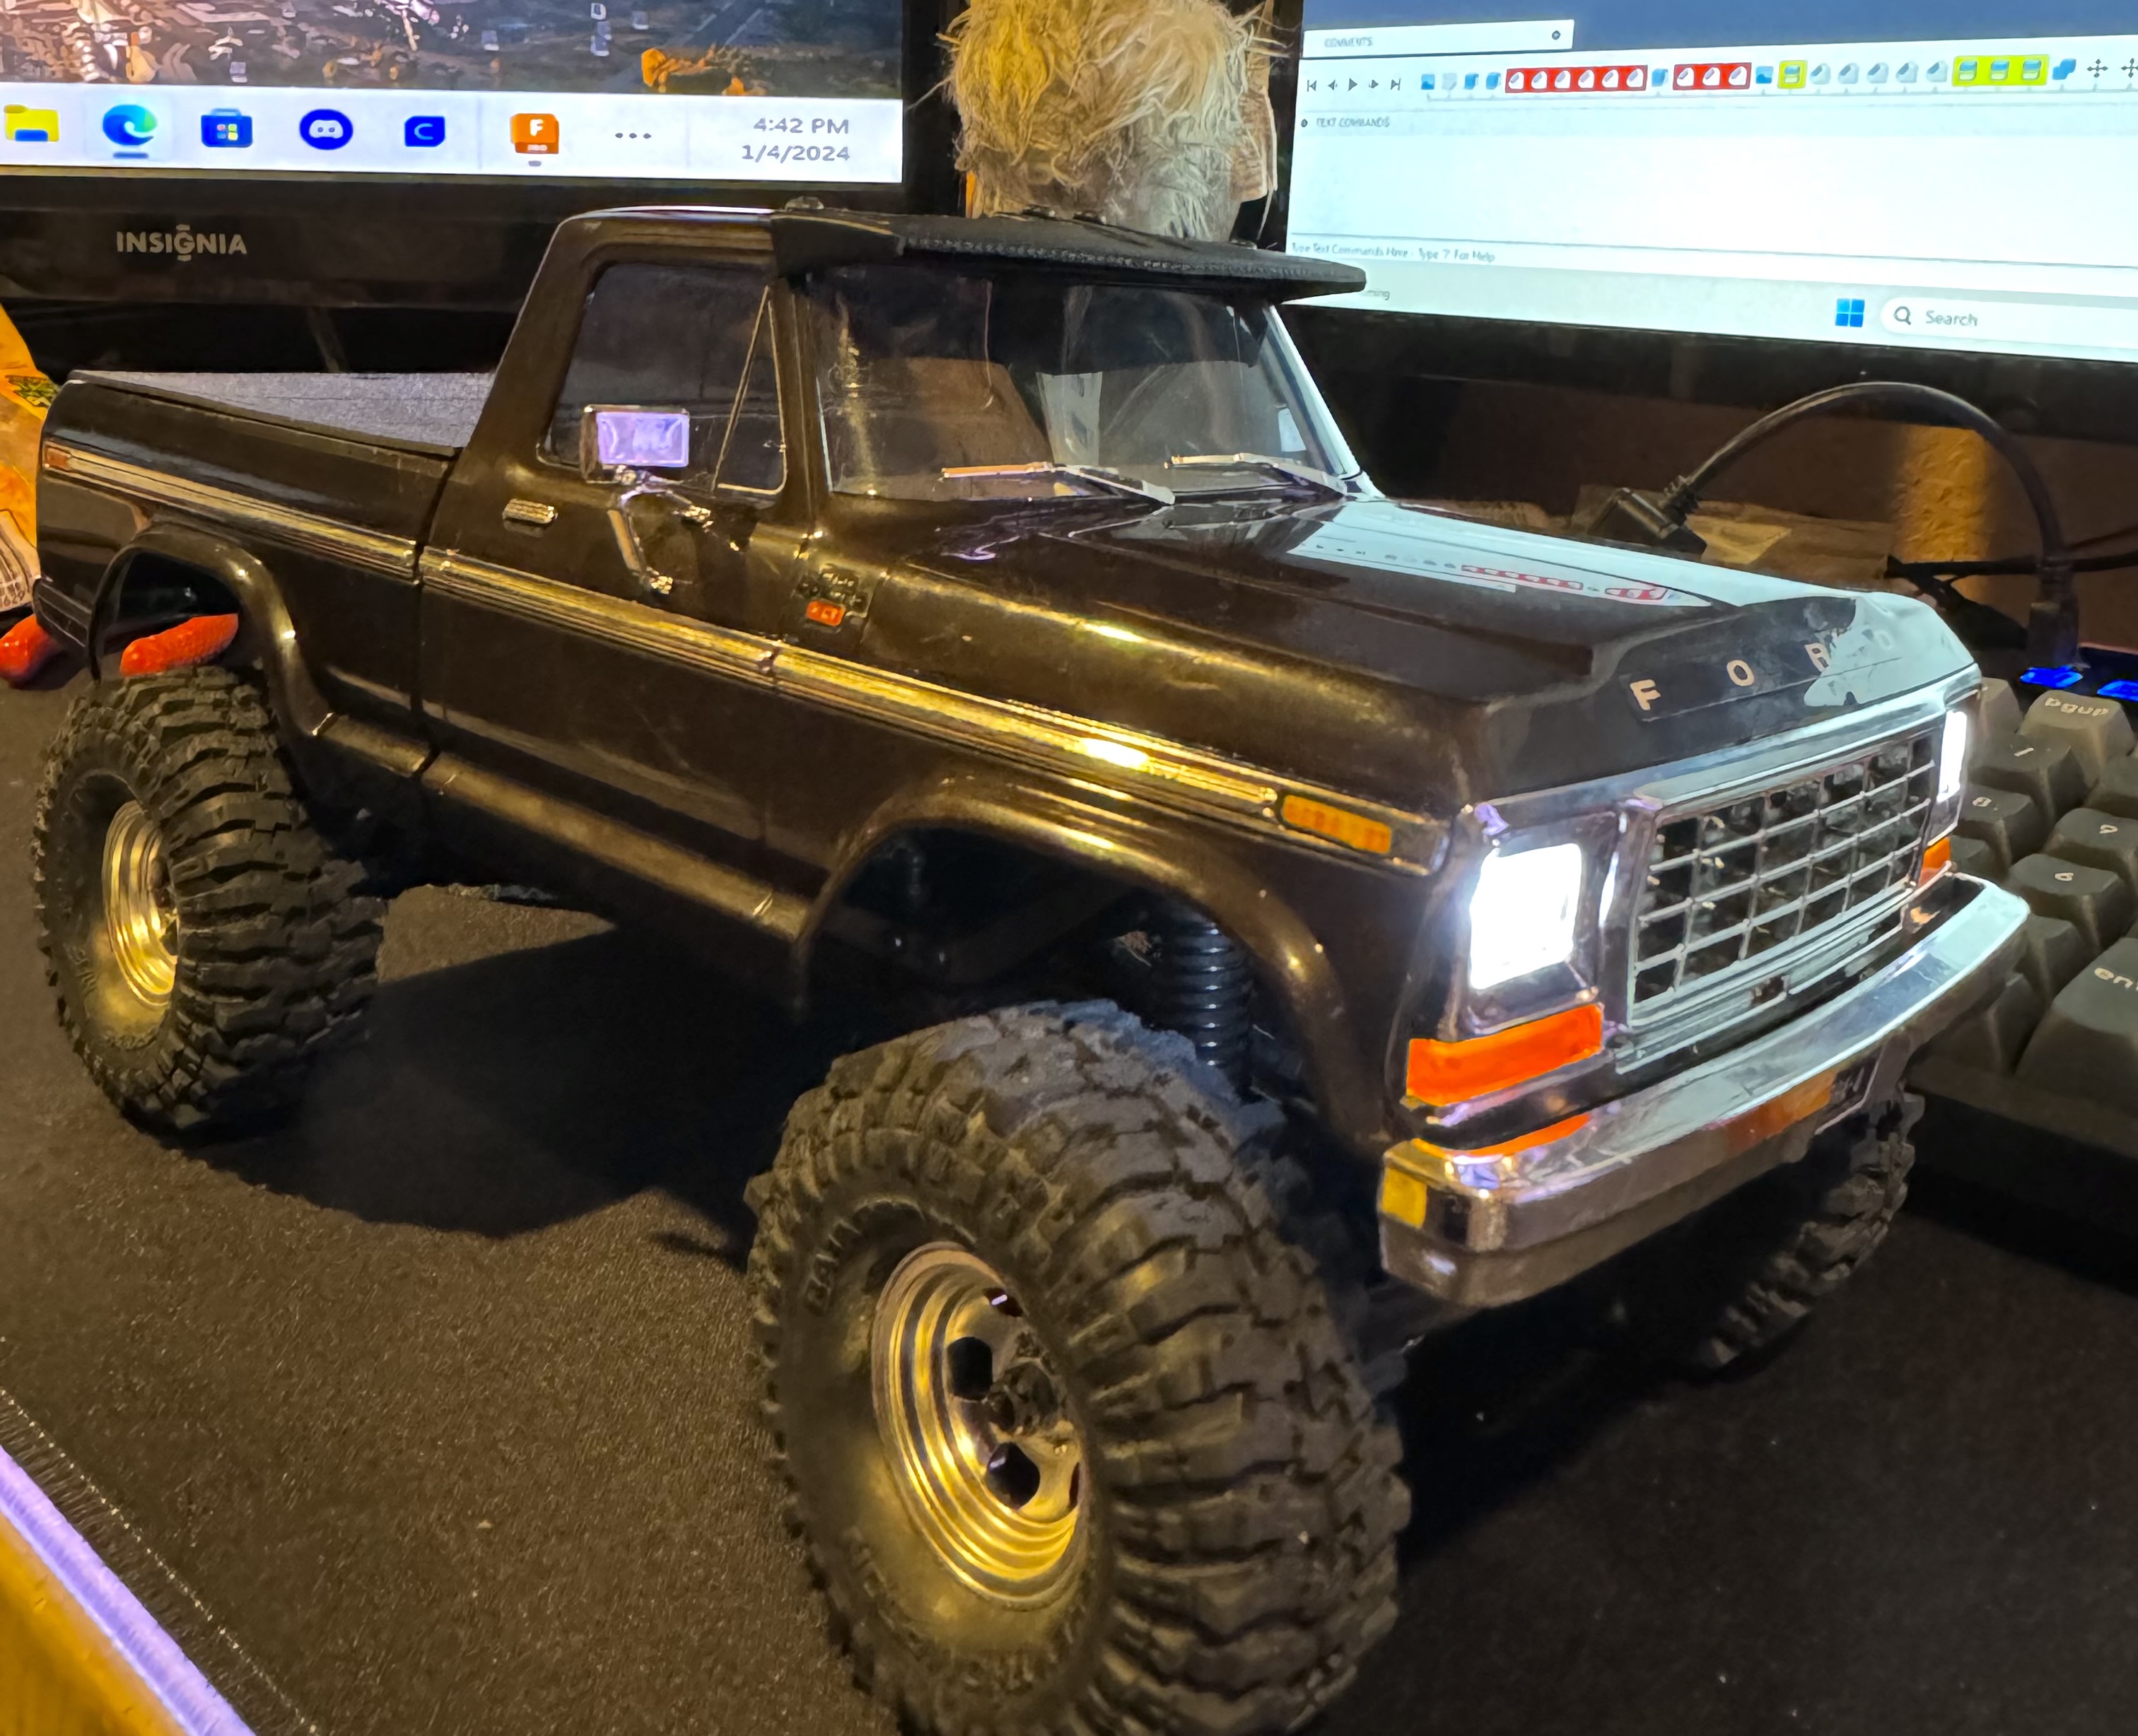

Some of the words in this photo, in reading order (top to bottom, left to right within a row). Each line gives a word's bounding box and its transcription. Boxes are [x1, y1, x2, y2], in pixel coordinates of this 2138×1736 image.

[753, 117, 804, 134] 4:42
[812, 118, 849, 134] PM
[741, 144, 851, 164] 1/4/2024
[115, 224, 247, 262] INSIGNIA
[1925, 310, 1978, 327] Search
[2093, 967, 2138, 992] en
